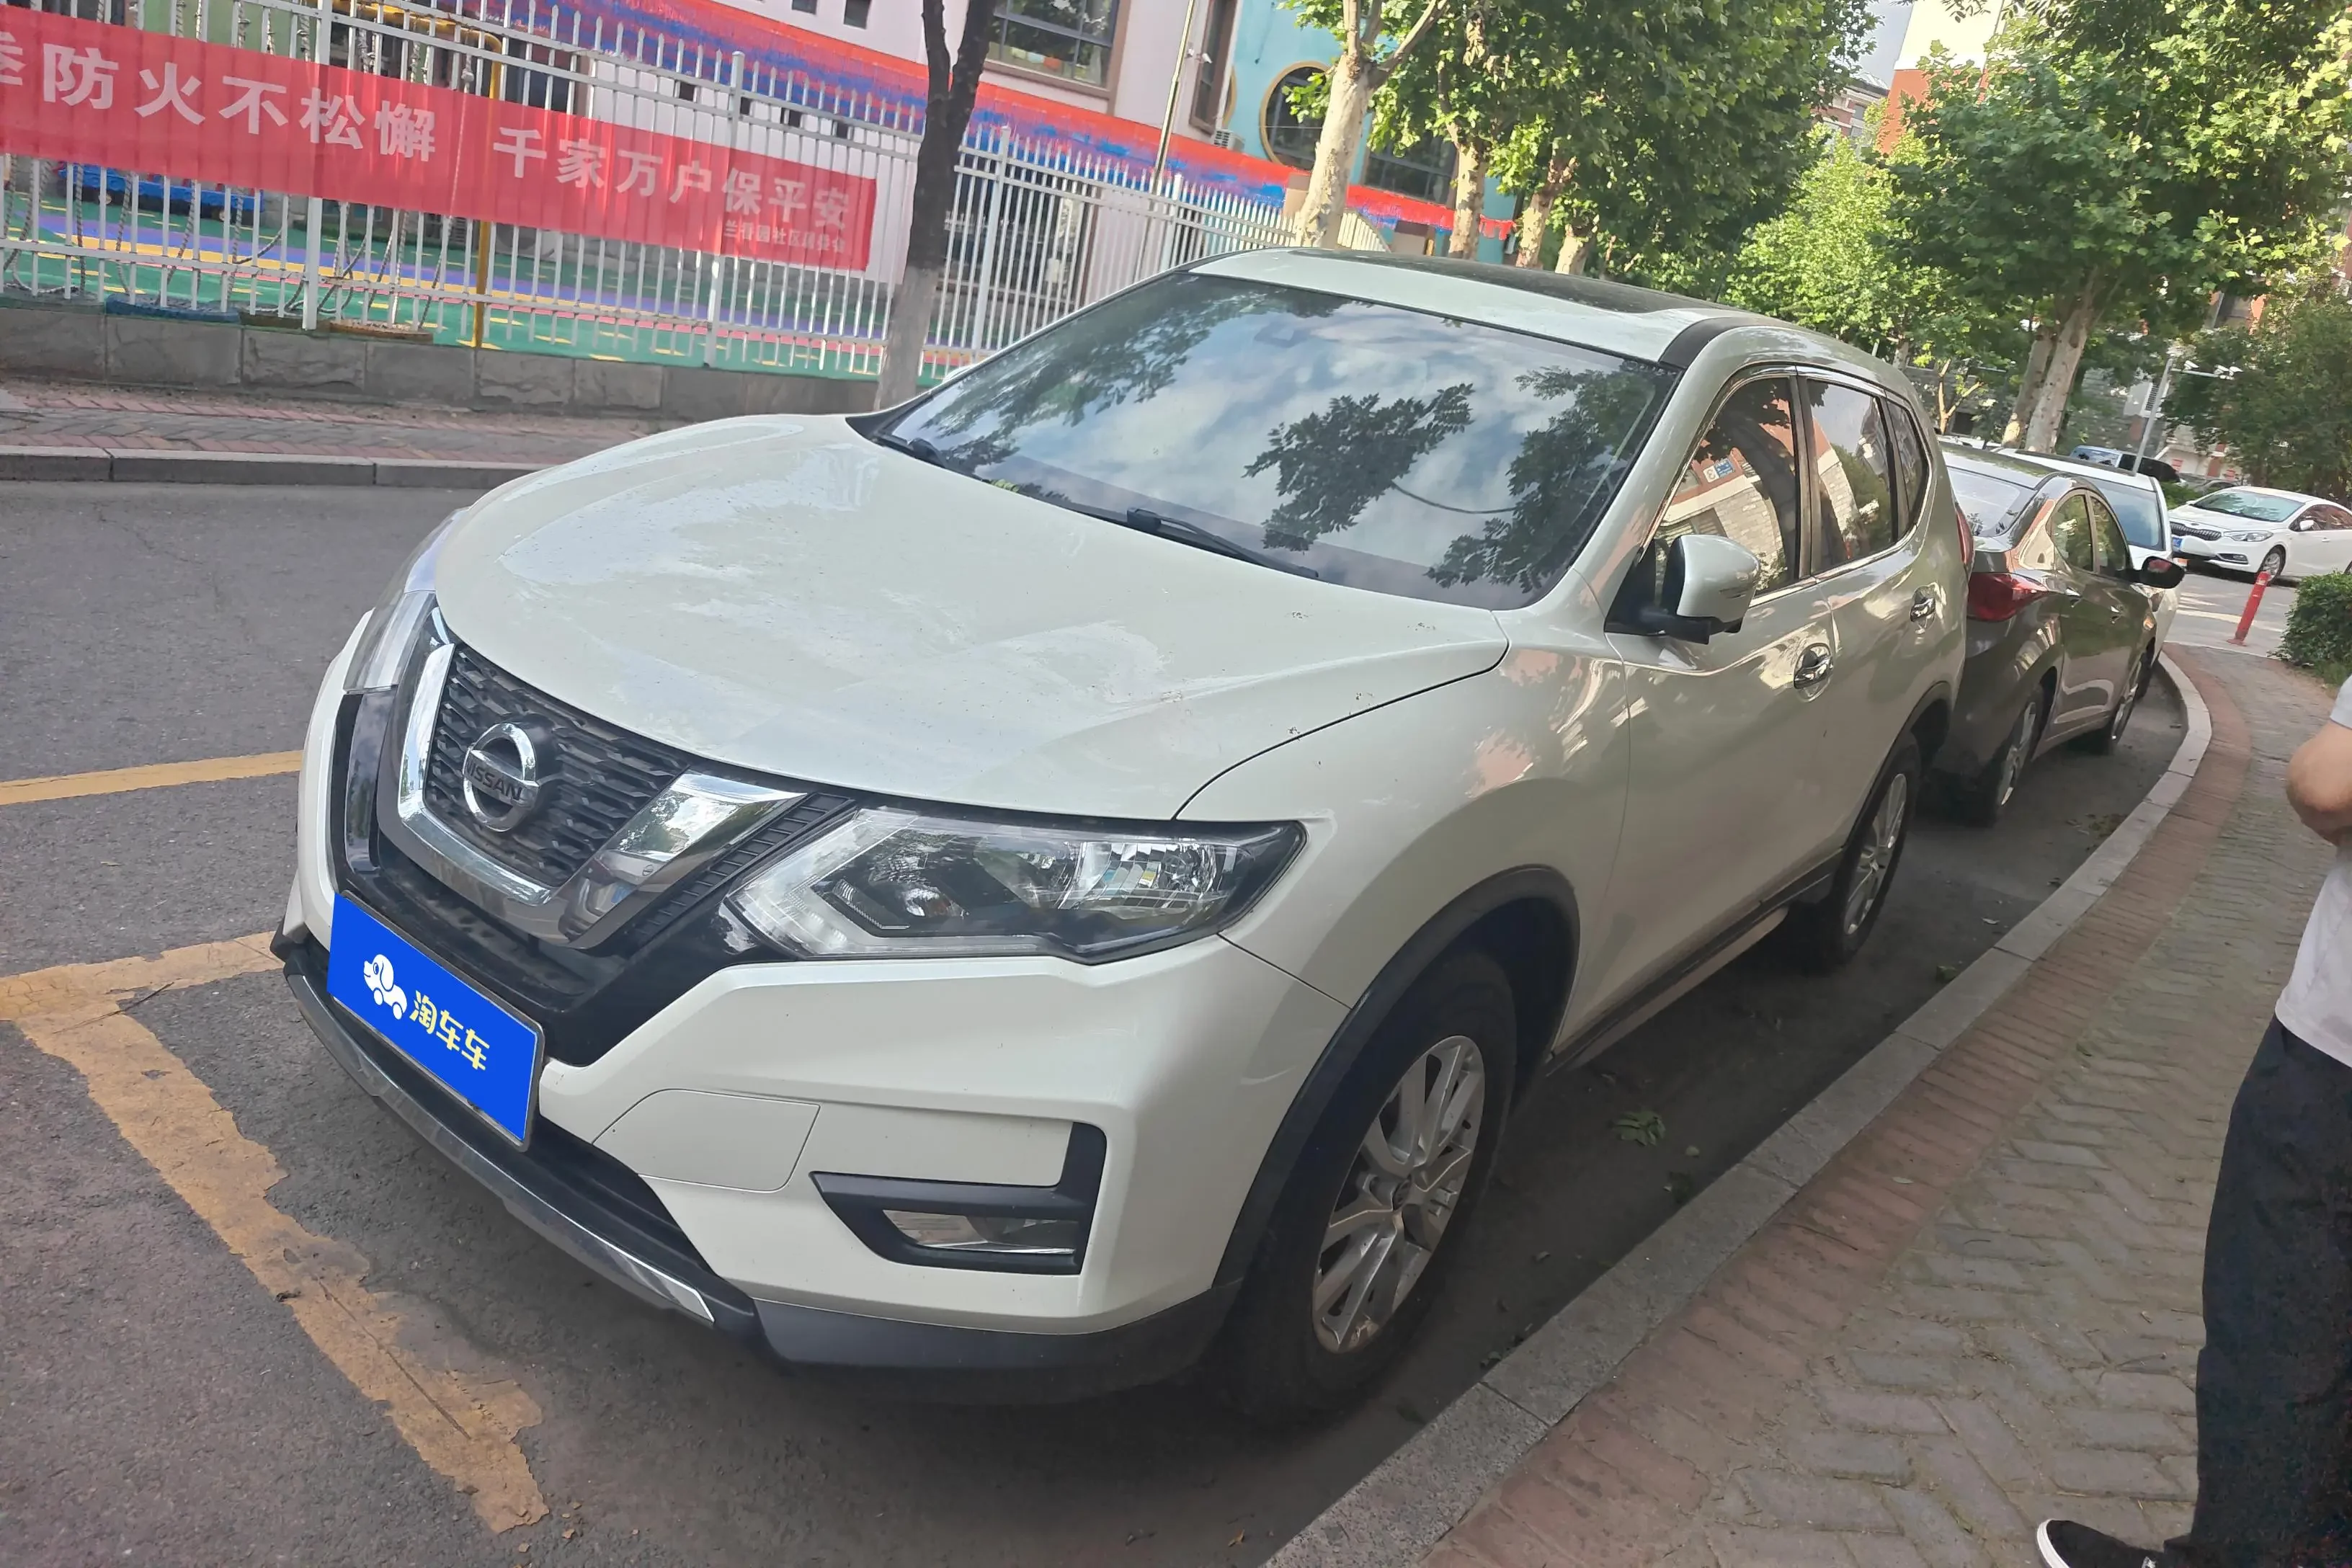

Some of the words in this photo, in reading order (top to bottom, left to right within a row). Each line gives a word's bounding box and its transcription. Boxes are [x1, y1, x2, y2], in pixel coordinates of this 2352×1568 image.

[493, 127, 849, 230] 千家万户保平安
